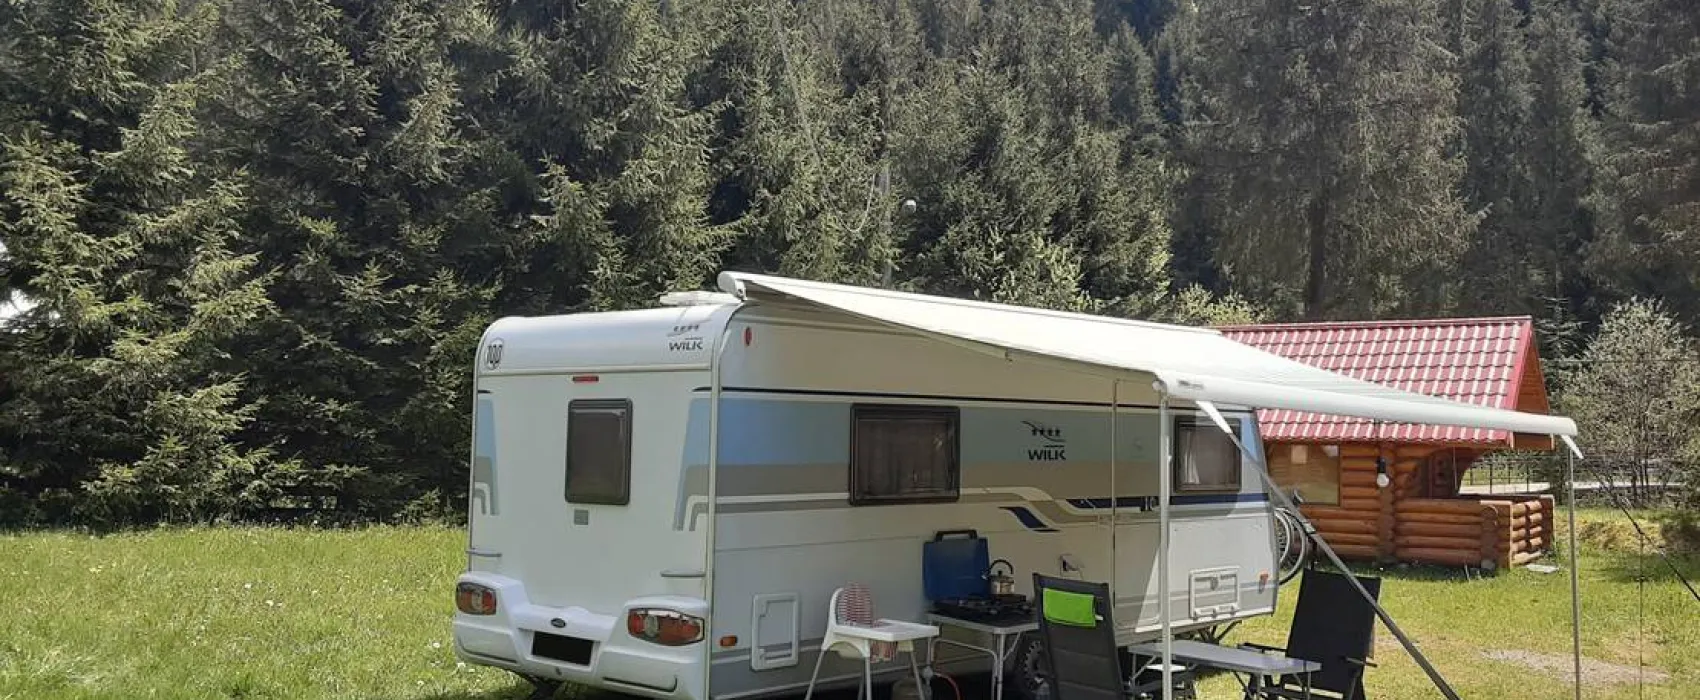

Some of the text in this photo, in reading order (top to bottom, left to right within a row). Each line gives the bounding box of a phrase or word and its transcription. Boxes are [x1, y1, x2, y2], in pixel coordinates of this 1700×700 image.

[669, 341, 703, 350] WILK
[487, 344, 503, 364] 100
[1028, 449, 1066, 461] WILK
